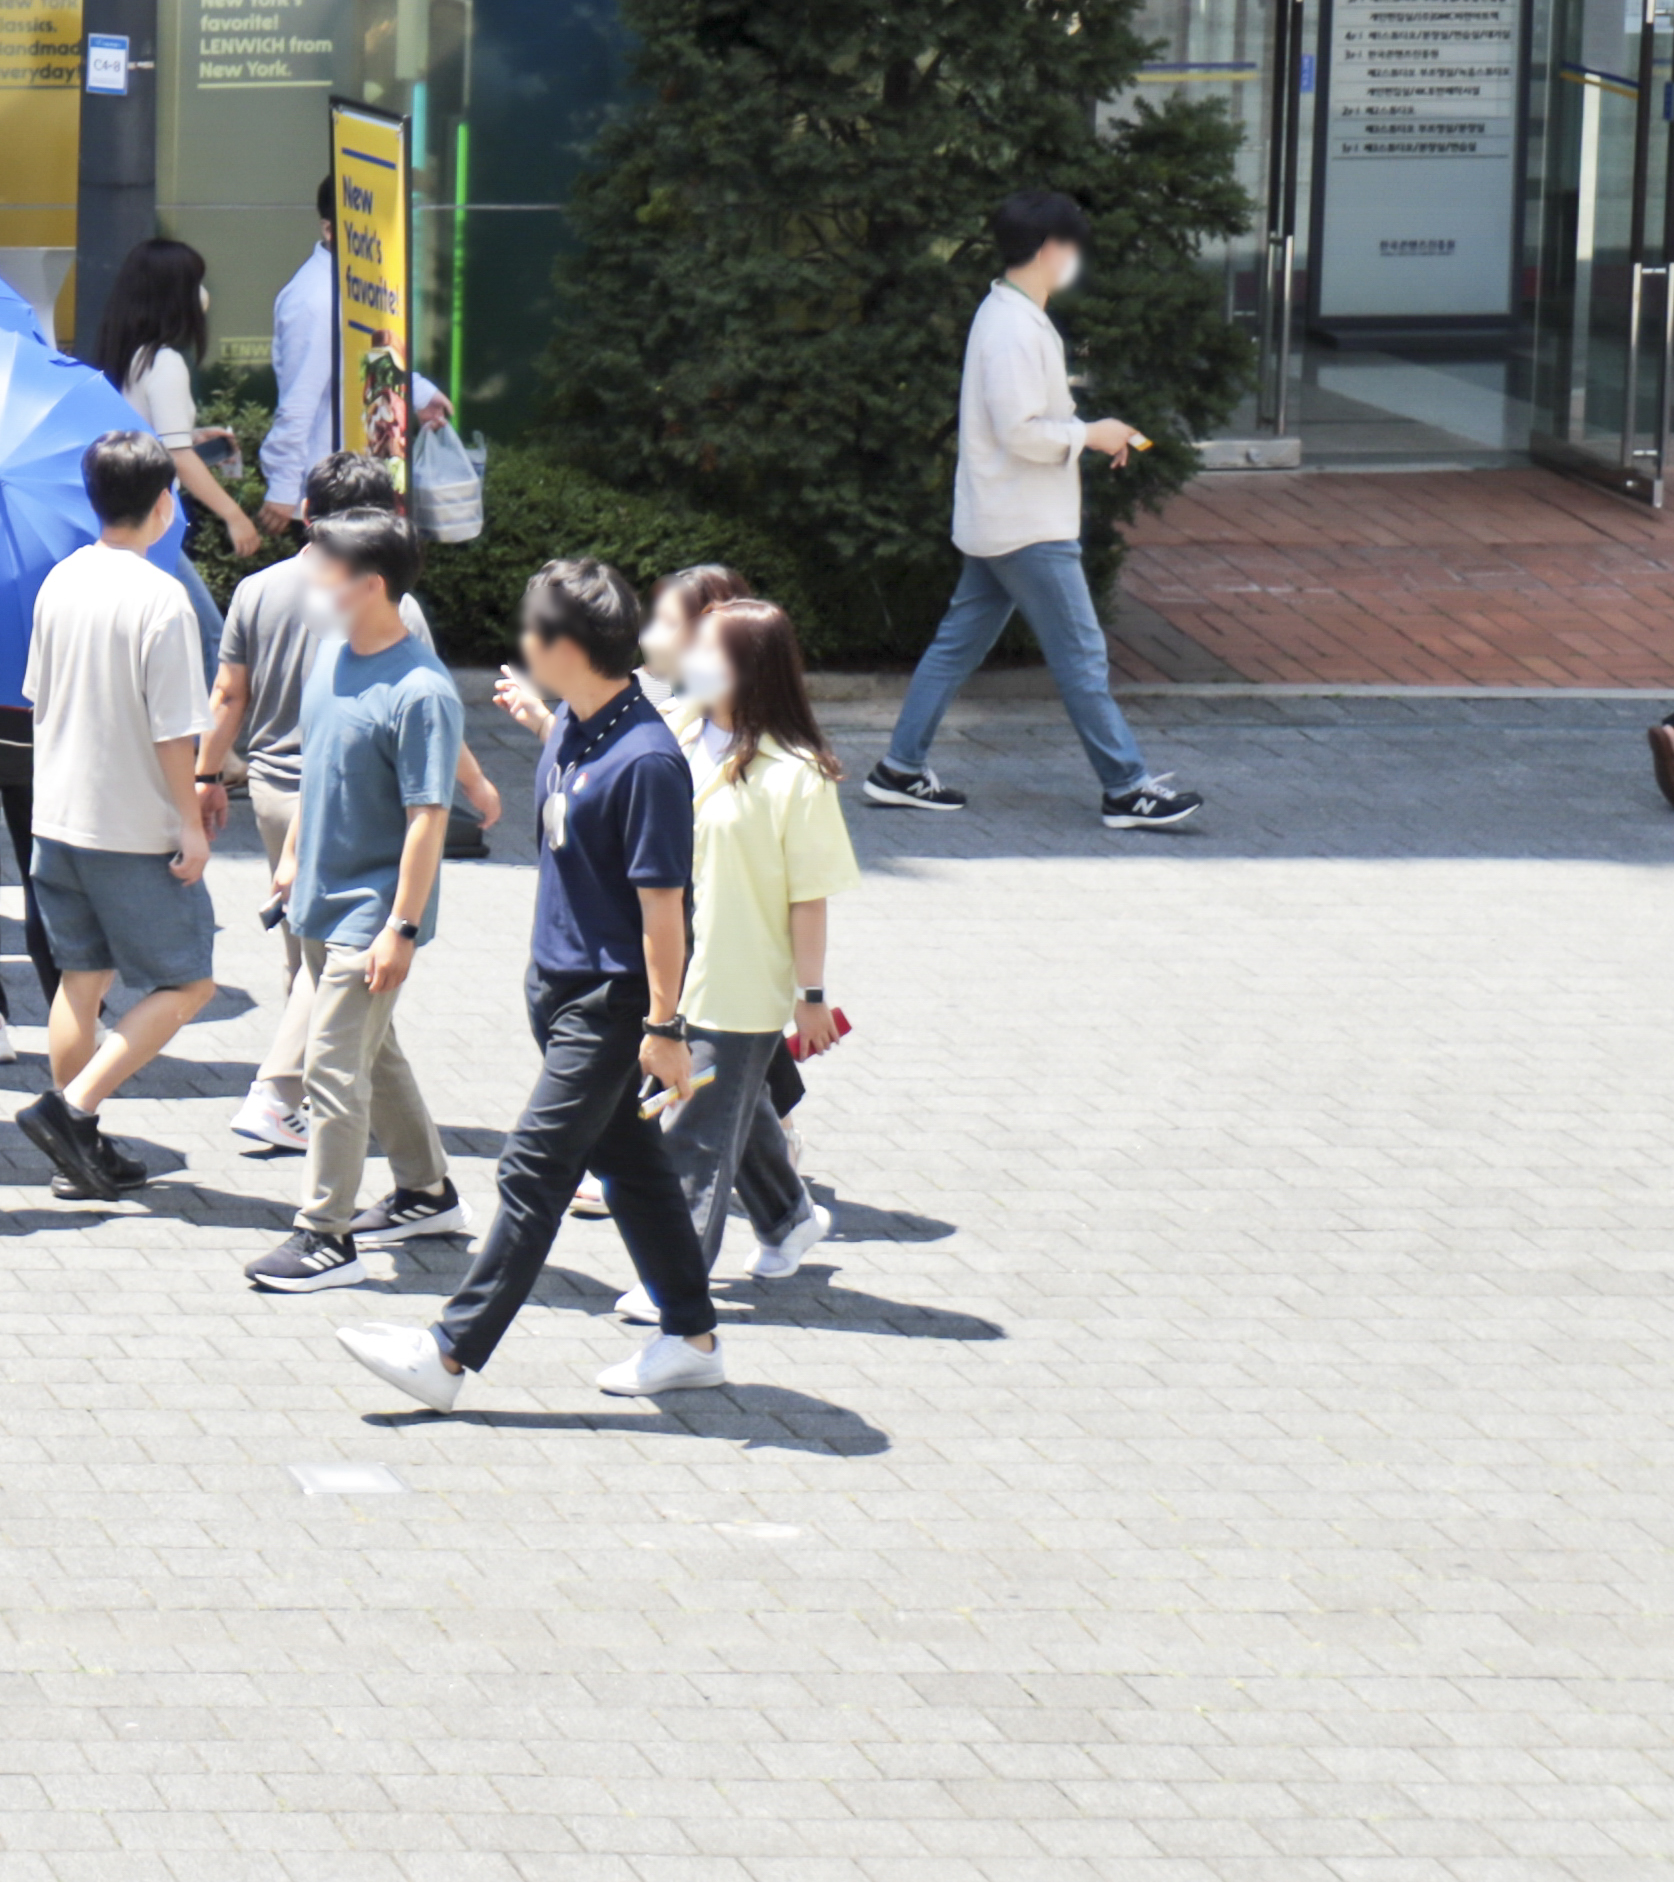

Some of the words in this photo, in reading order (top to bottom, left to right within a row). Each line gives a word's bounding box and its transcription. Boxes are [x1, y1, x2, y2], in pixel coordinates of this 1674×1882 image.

[200, 14, 279, 32] favorite!
[200, 37, 285, 55] LENWICH
[289, 36, 333, 53] from
[199, 61, 243, 78] New
[246, 60, 293, 77] York.
[342, 174, 373, 215] New
[344, 219, 383, 266] York's
[346, 264, 400, 316] favorite!
